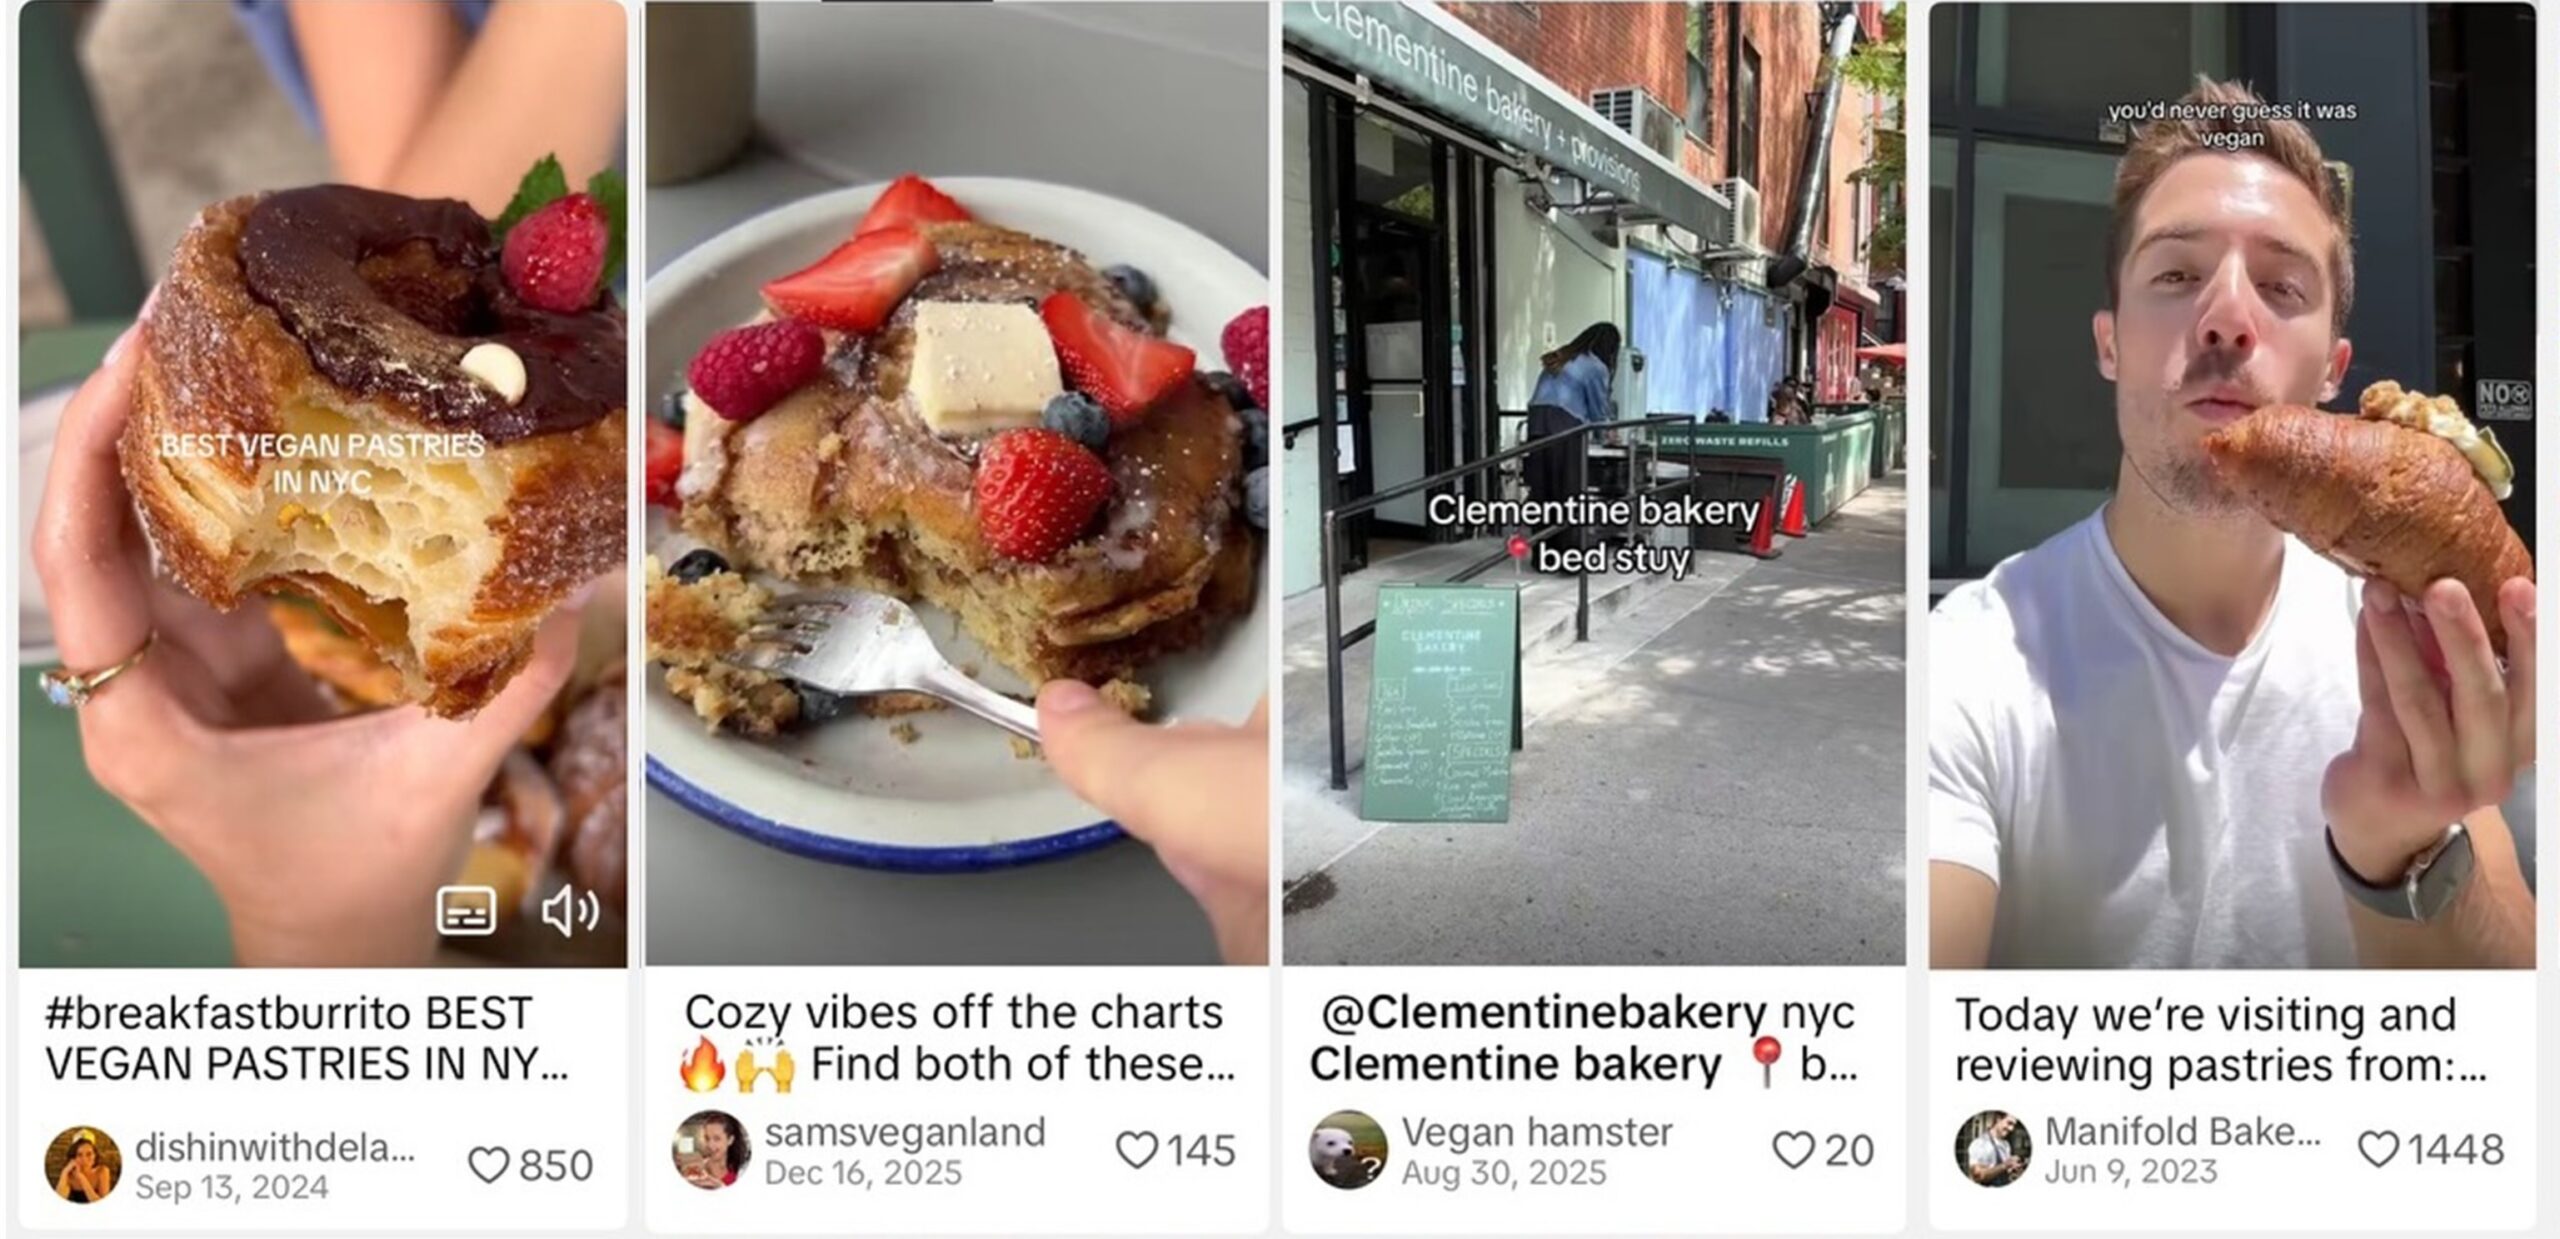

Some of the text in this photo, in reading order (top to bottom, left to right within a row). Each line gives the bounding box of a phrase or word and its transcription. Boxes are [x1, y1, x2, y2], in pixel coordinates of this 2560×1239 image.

[1486, 75, 1552, 151] bakery
[1557, 129, 1566, 148] +
[1571, 133, 1642, 193] provisions
[2480, 383, 2510, 405] NO
[1694, 436, 1735, 446] WASTE
[1738, 436, 1789, 447] REFILLS
[1401, 629, 1482, 642] CLEMENTINE
